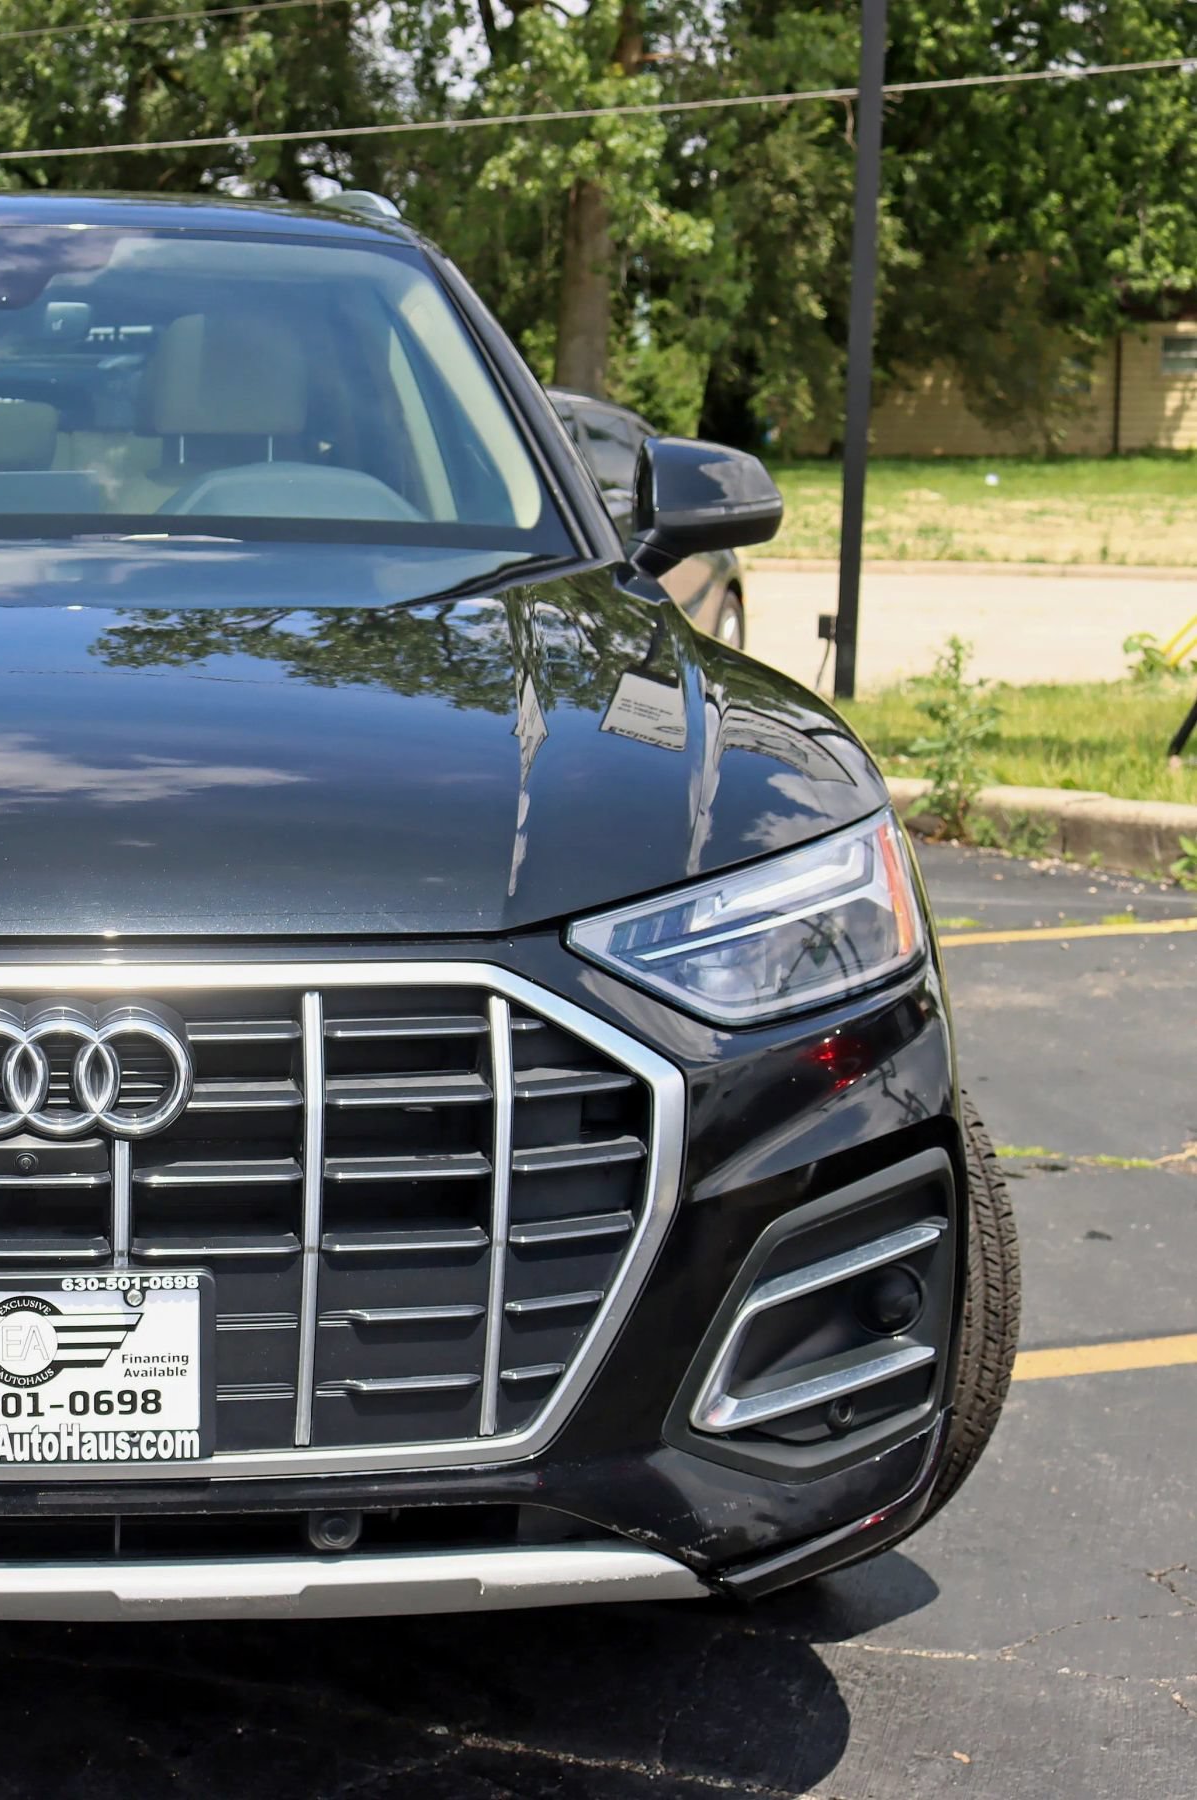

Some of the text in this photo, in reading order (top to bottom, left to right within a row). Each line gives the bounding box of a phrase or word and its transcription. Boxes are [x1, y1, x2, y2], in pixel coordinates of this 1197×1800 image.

[61, 1276, 199, 1291] 630-501-0698
[1, 1325, 50, 1362] EA
[121, 1353, 189, 1366] Financing
[123, 1366, 188, 1378] Available
